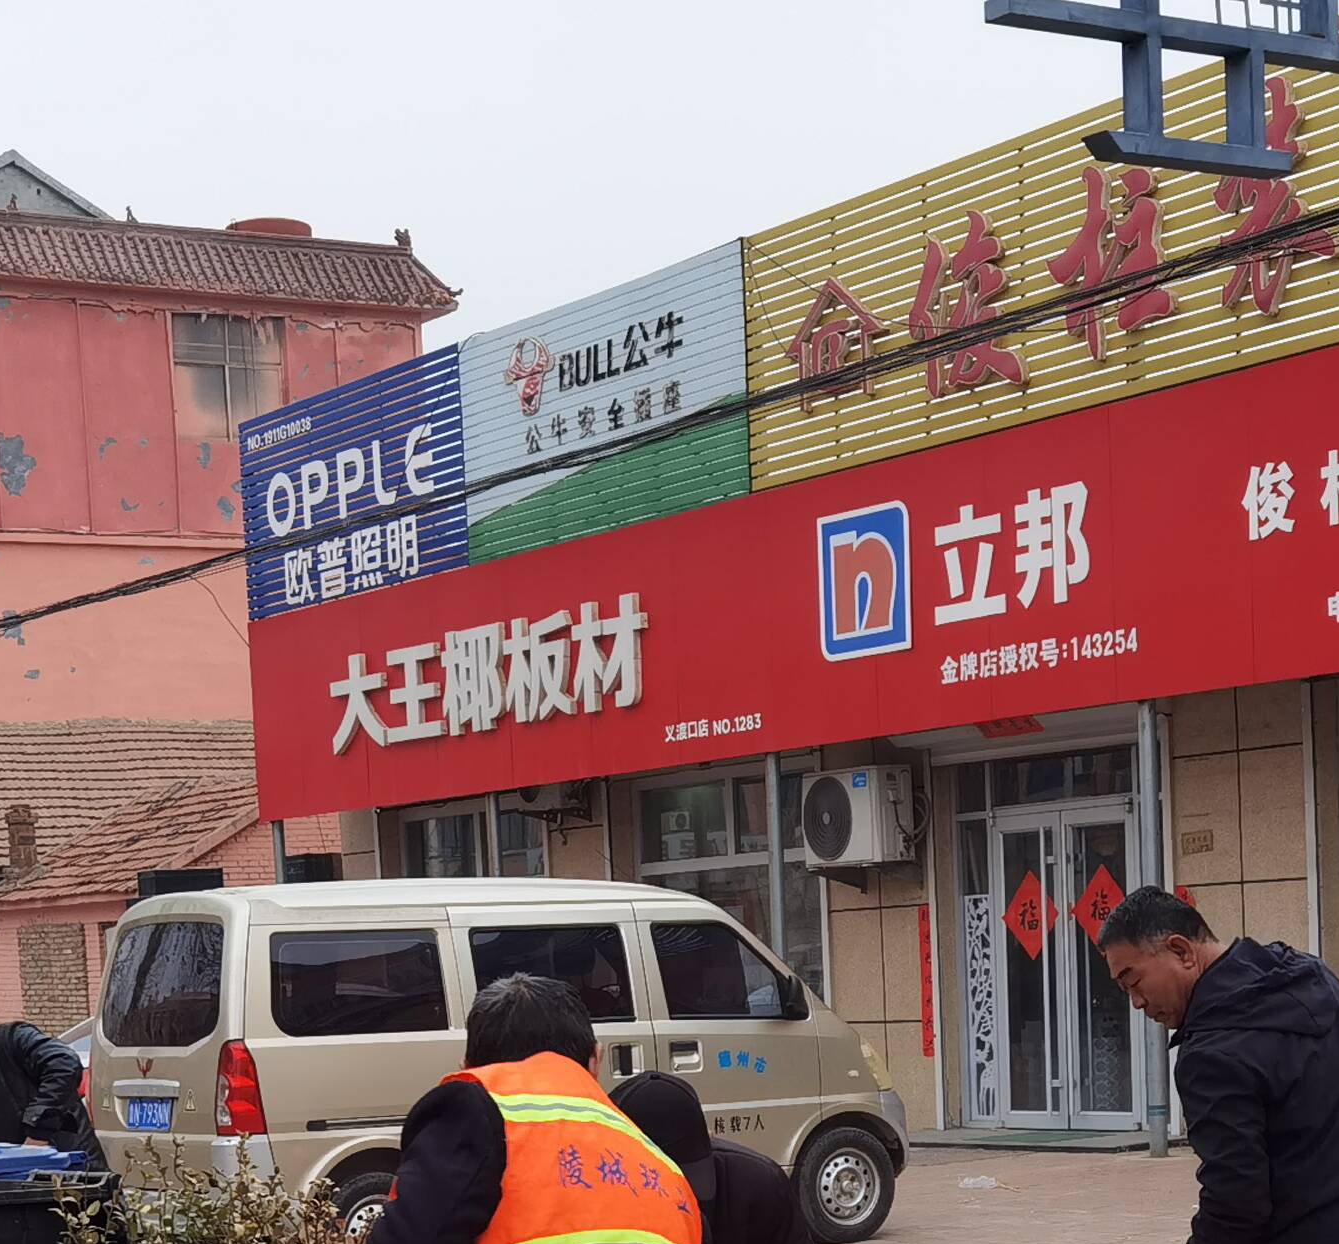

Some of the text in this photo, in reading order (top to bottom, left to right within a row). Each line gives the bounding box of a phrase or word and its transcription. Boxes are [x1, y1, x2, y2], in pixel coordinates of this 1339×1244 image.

[266, 422, 435, 537] OPPLE
[284, 514, 420, 605] 欧普照明
[934, 481, 1091, 626] 立邦
[329, 592, 649, 756] 大王椰板材
[665, 712, 762, 743] 义渡口店 NO.1283
[1019, 898, 1040, 930] 福
[1091, 887, 1112, 921] 福
[714, 1114, 765, 1135] 核载7人
